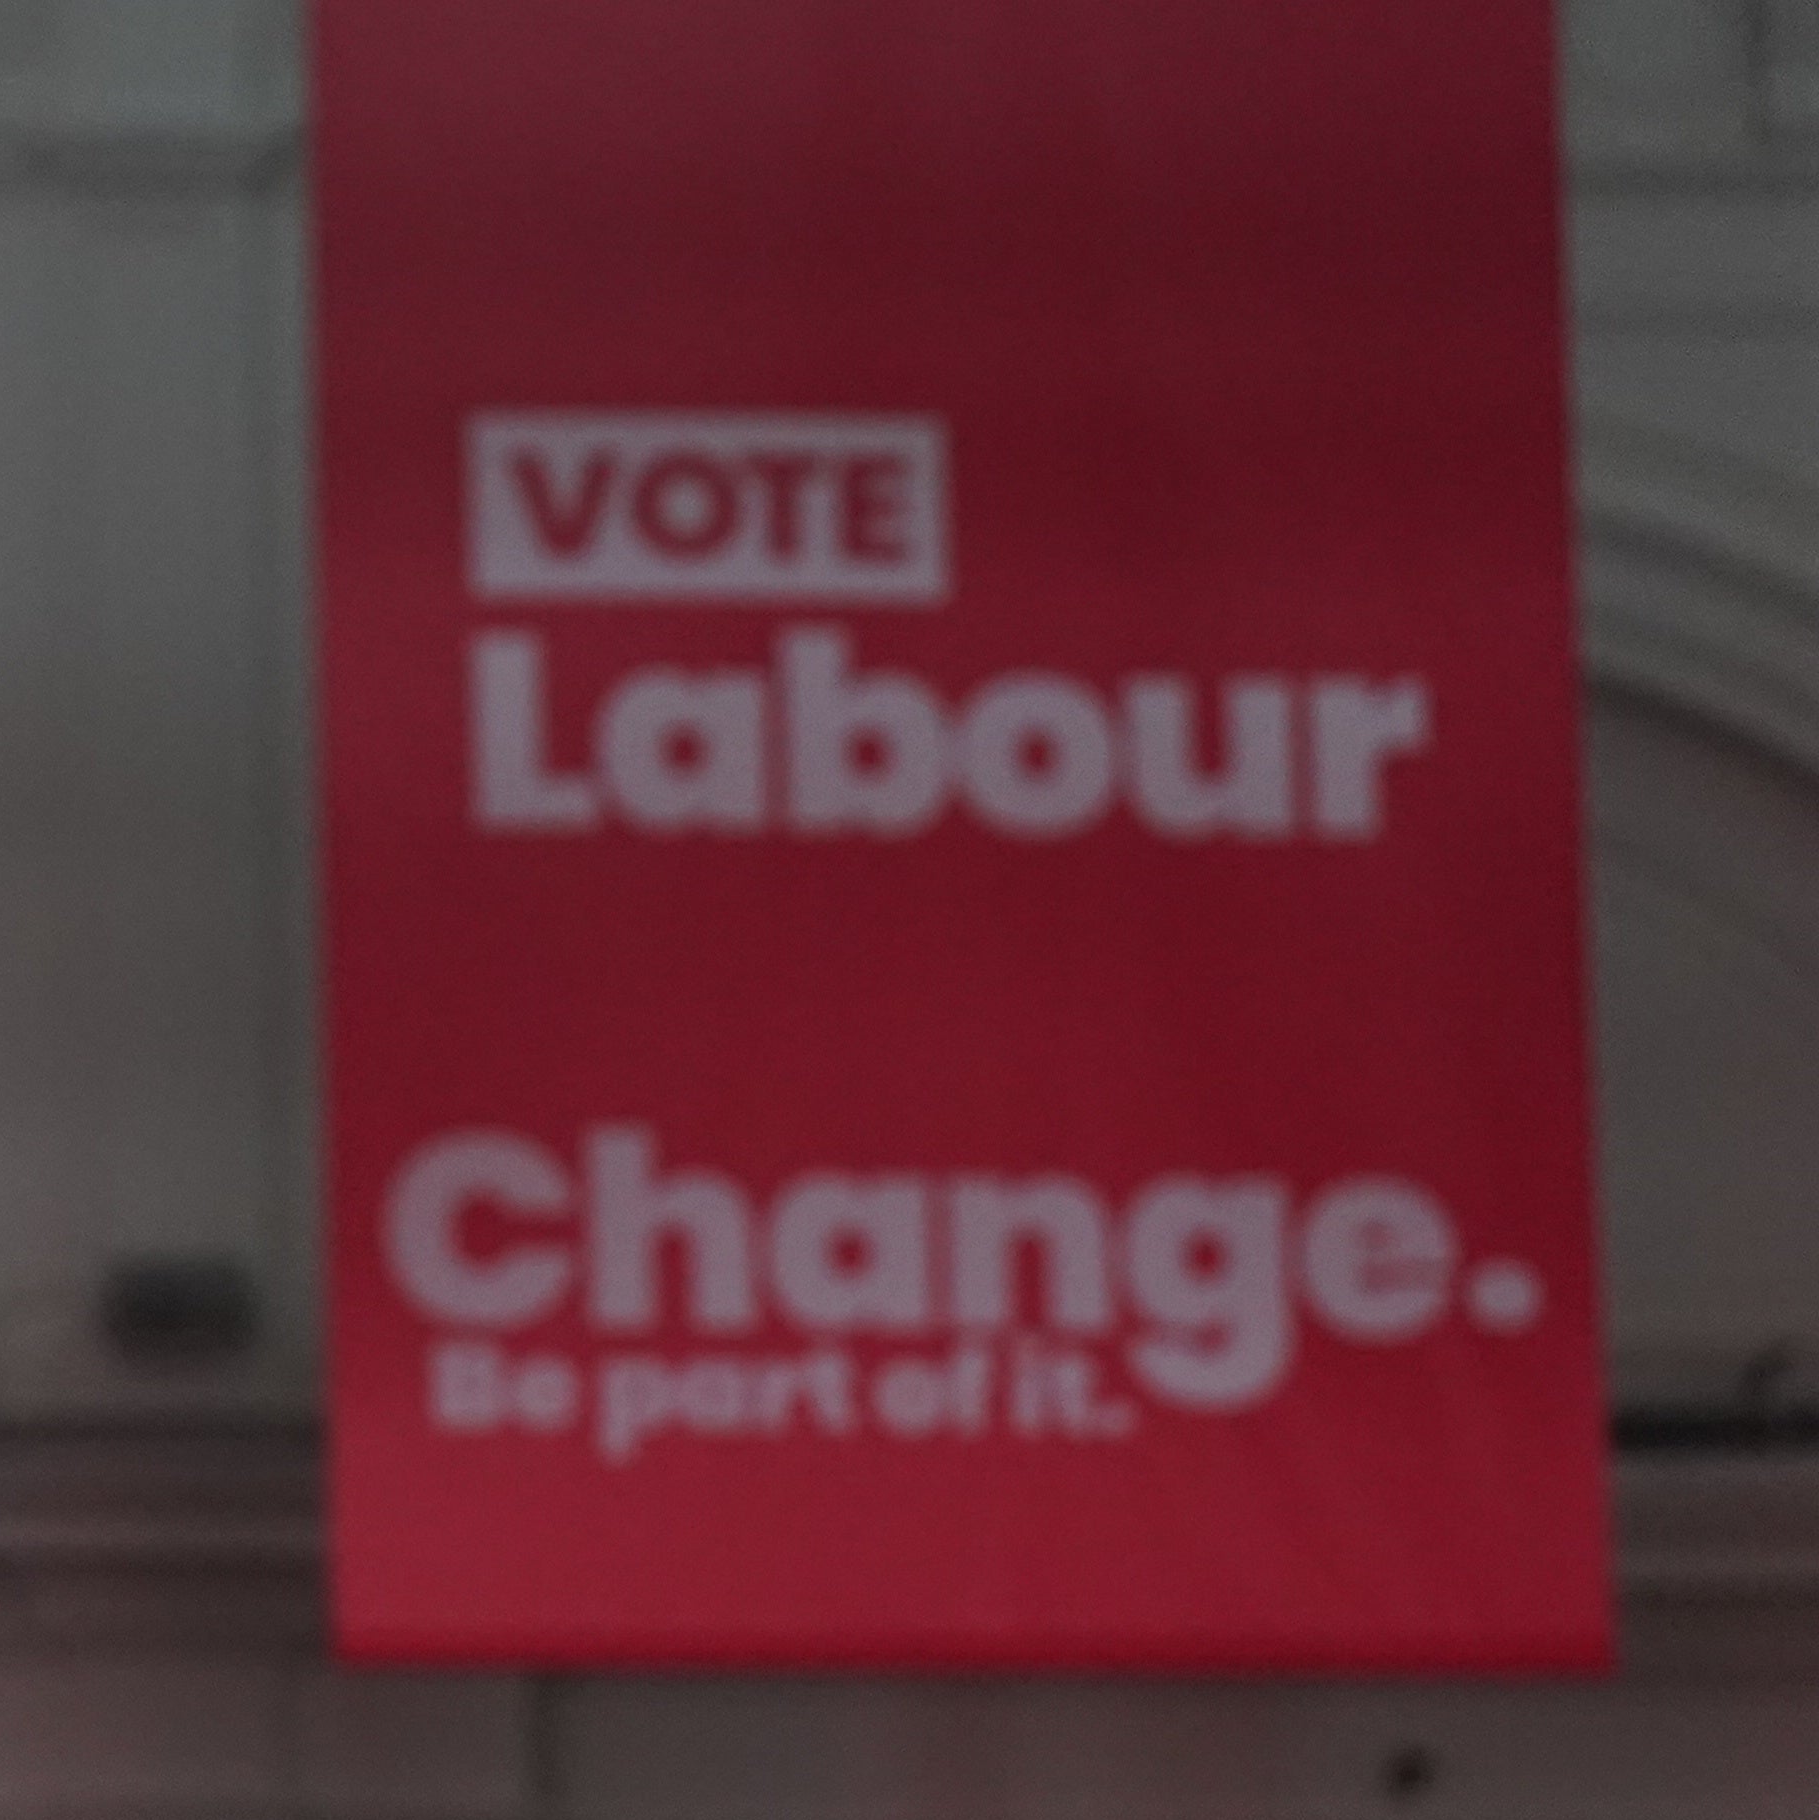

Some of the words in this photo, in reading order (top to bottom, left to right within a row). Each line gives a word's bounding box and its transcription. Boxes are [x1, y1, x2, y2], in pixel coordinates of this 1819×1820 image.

[509, 447, 911, 566] VOTE
[466, 623, 1429, 838] Labour
[383, 1122, 1541, 1405] Change.
[429, 1338, 580, 1432] Be
[595, 1343, 855, 1464] part
[870, 1336, 995, 1438] of
[1005, 1336, 1135, 1440] it.
